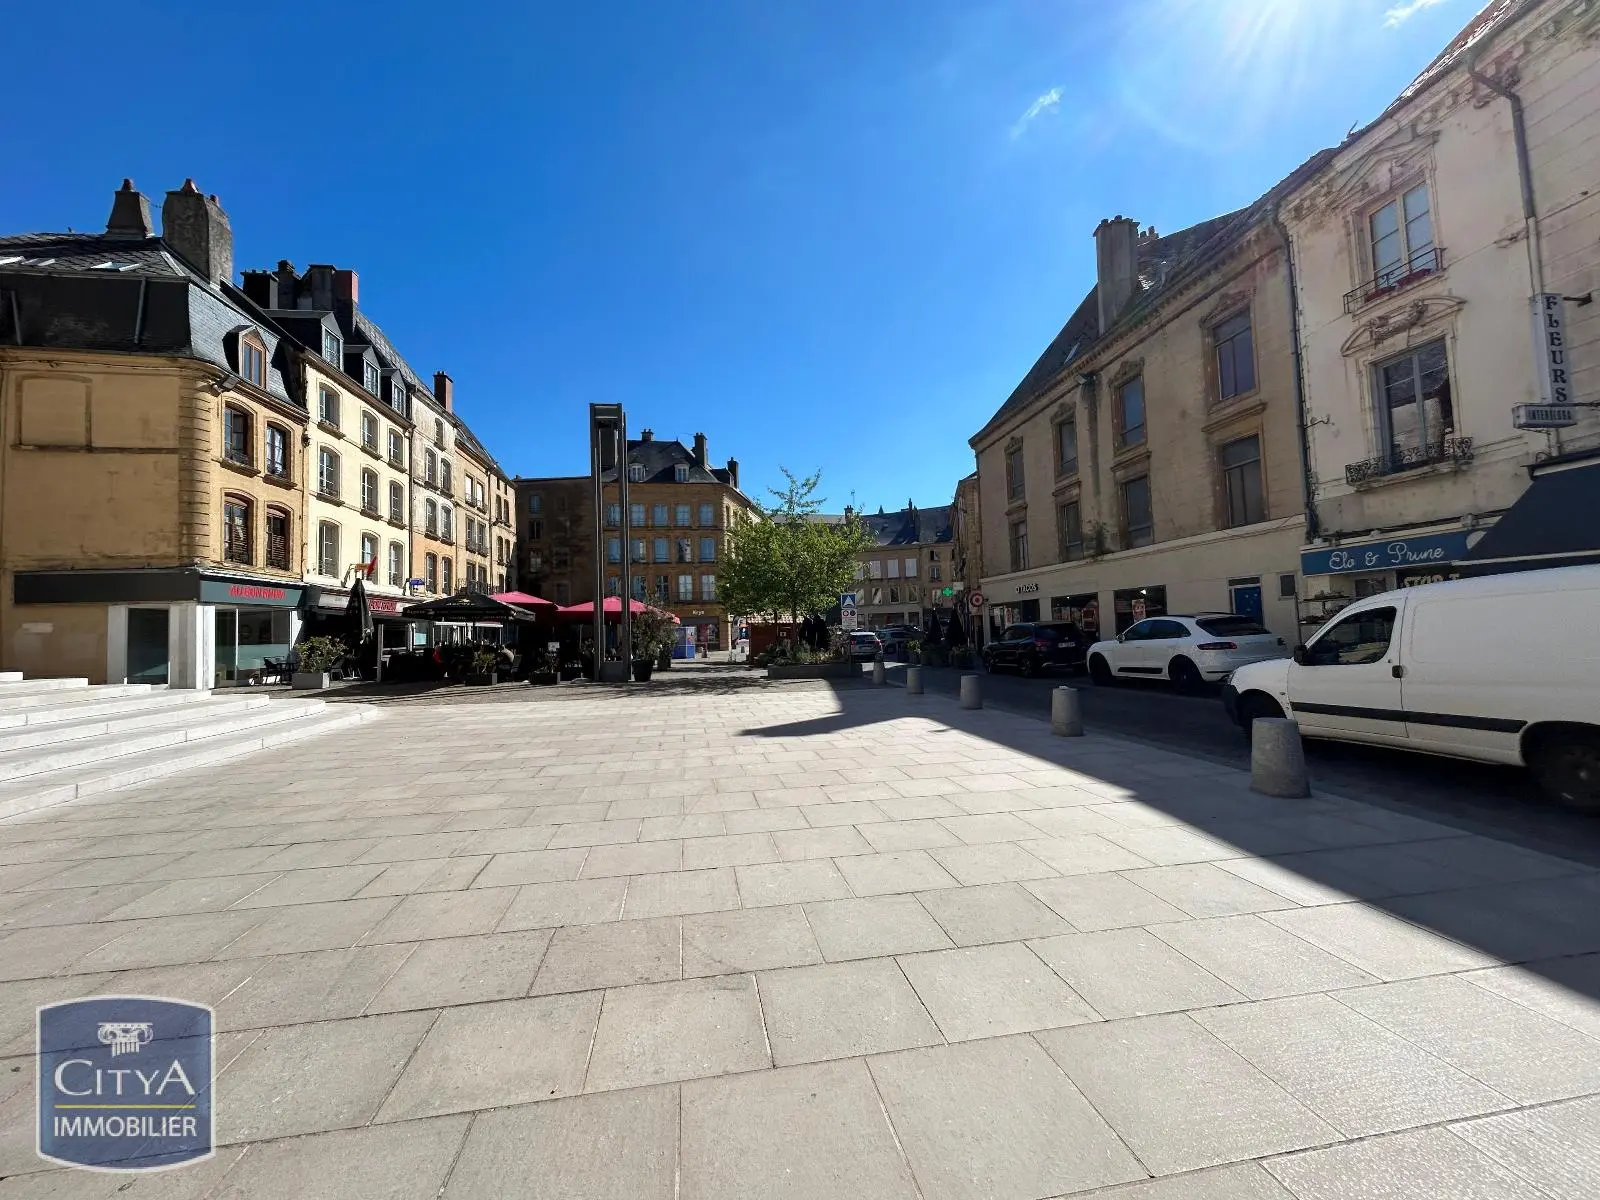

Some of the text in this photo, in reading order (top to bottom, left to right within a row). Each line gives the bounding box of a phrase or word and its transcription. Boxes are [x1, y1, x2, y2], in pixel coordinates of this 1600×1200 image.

[1544, 295, 1567, 403] FLEURS
[1365, 551, 1380, 566] &
[1387, 542, 1444, 563] Prune
